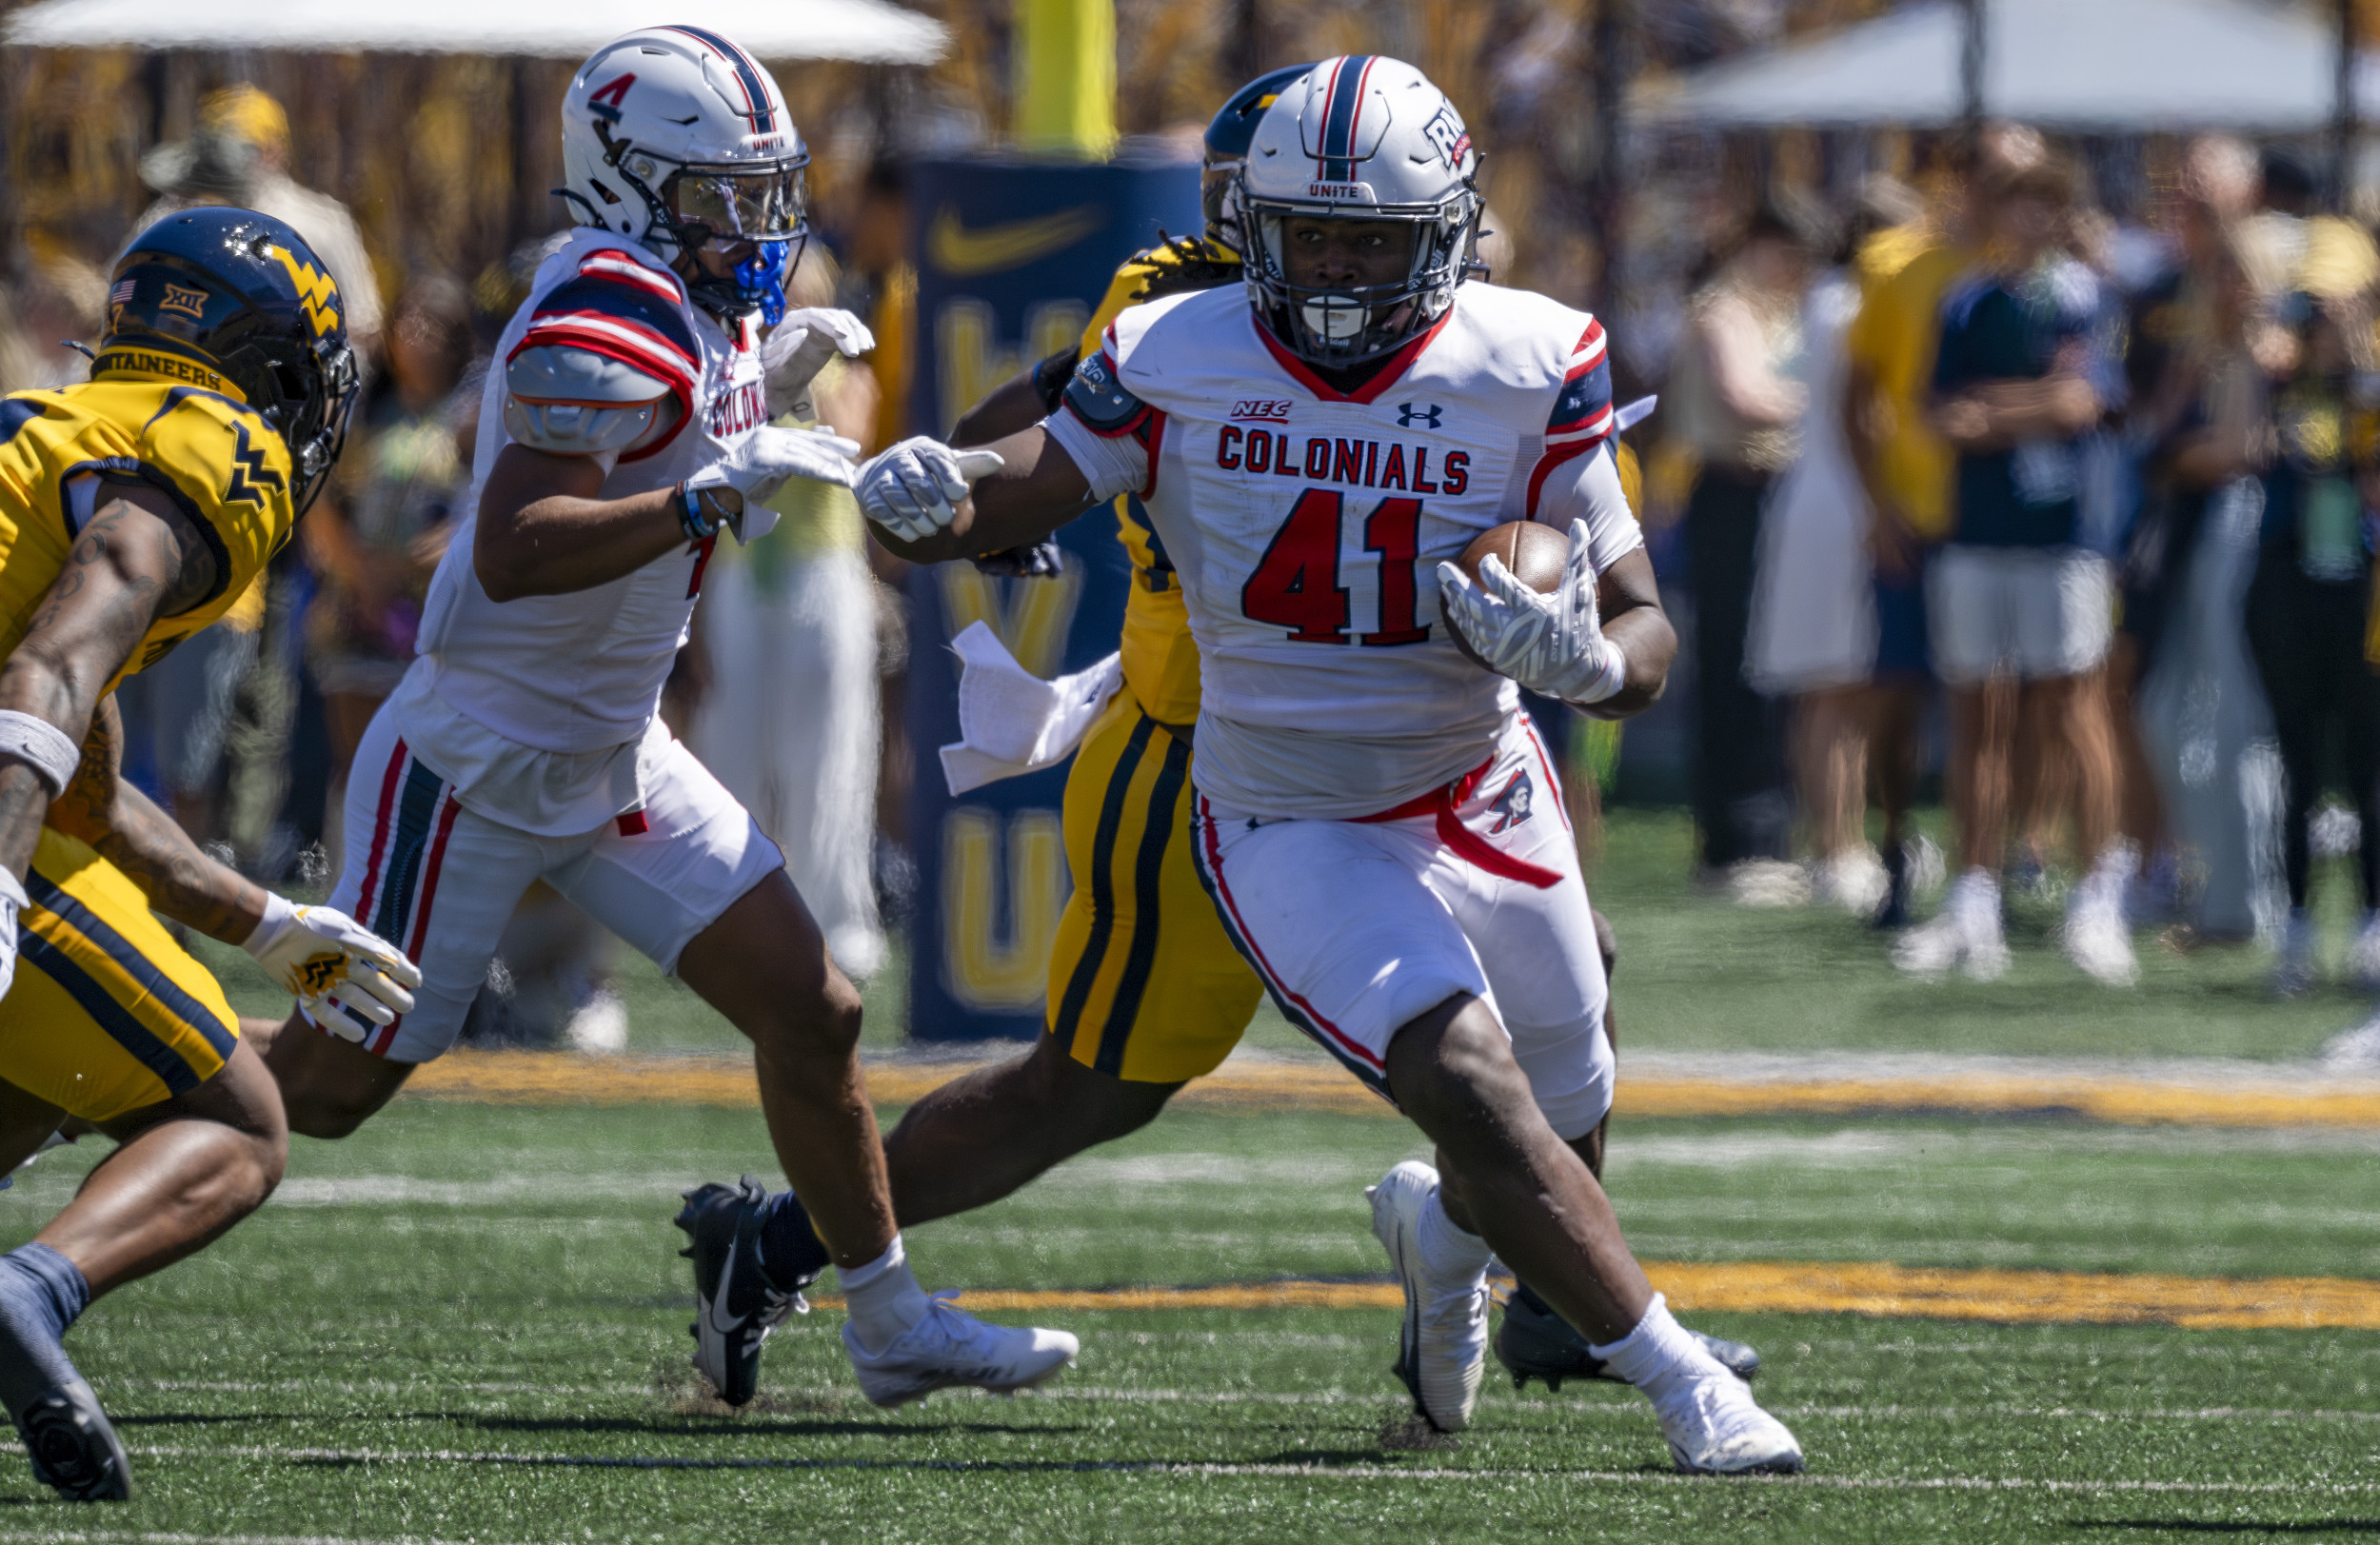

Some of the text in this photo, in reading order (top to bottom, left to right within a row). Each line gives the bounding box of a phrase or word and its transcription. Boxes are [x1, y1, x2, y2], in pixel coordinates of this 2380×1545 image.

[753, 135, 785, 151] UNITE
[1310, 183, 1359, 198] UNITE
[1230, 399, 1292, 417] NEC
[1218, 425, 1471, 495] COLONIALS
[1240, 486, 1431, 646] 41
